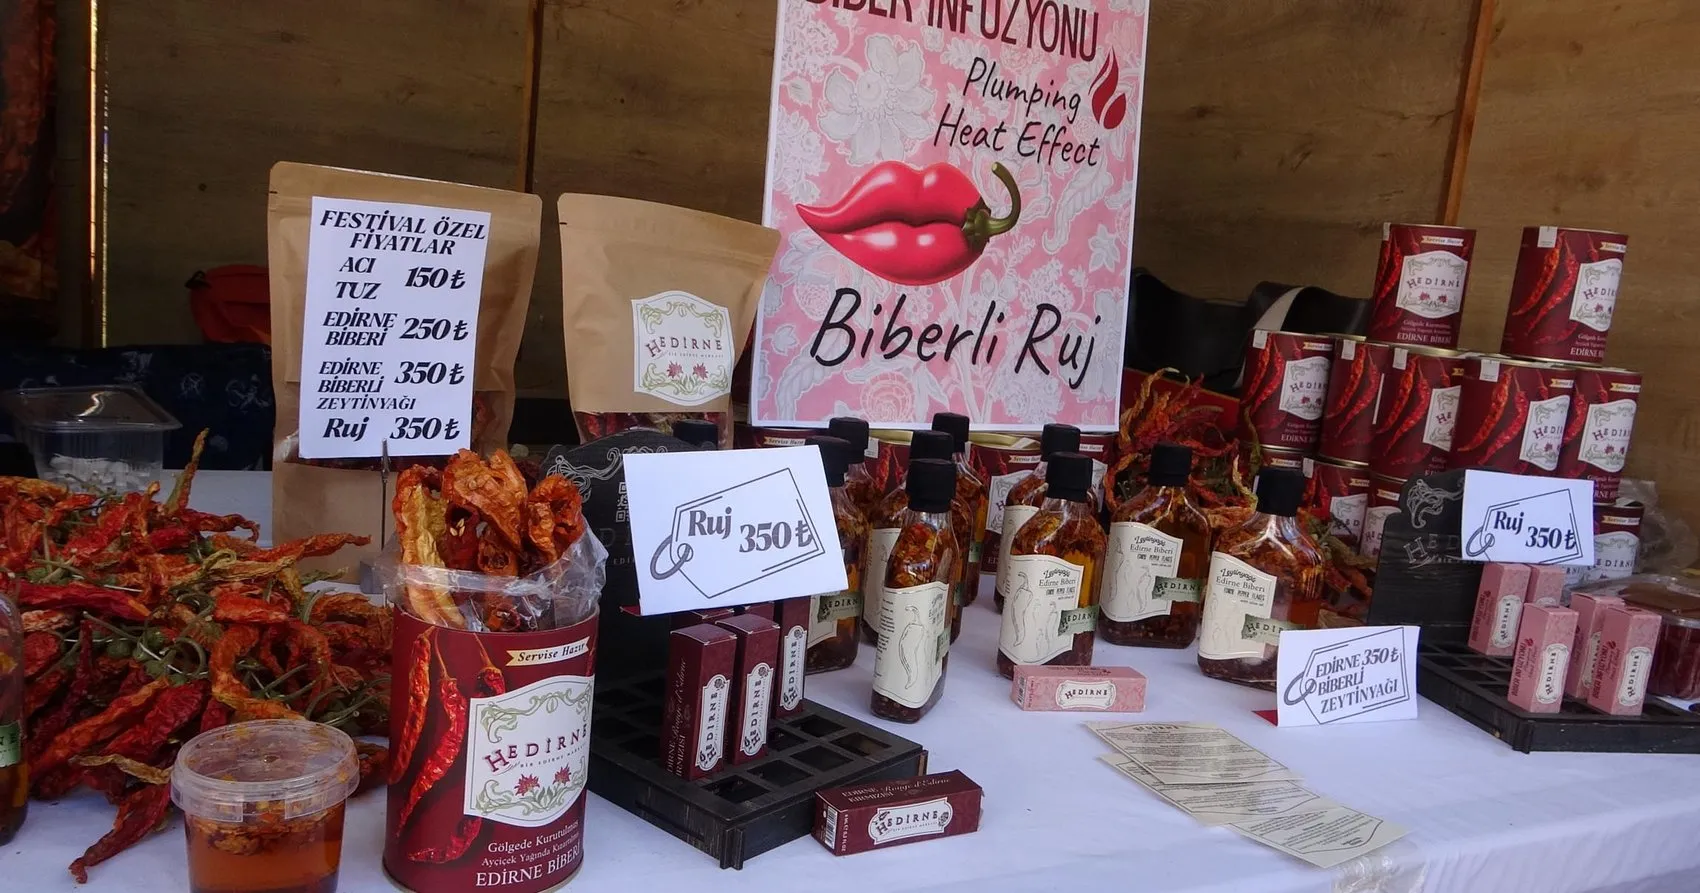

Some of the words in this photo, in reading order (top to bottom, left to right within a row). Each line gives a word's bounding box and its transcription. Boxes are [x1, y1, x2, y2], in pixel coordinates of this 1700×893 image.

[963, 56, 1081, 124] Plumping
[934, 104, 1007, 151] Heat
[1017, 121, 1100, 166] Effect
[320, 210, 427, 234] FESTİVAL
[433, 216, 486, 240] ÖZEL
[349, 229, 456, 255] FİYATLAR
[339, 256, 376, 273] ACI
[336, 281, 381, 300] TUZ
[322, 307, 398, 328] EDİRNE
[325, 327, 388, 346] BİBERİ
[810, 288, 1005, 367] Biberli
[1014, 303, 1102, 389] Ruj
[319, 357, 383, 375] EDİRNE
[317, 376, 385, 393] BİBERLİ
[316, 394, 416, 411] ZEYTİNYAĞI
[323, 416, 370, 442] Ruj
[688, 506, 732, 540] Ruj
[1494, 511, 1524, 535] Ruj
[1216, 576, 1241, 588] Edirne
[1242, 581, 1265, 593] Biberi
[517, 650, 558, 662] Servise
[562, 642, 586, 657] Hazır
[1316, 653, 1361, 679] EDİRNE
[1318, 667, 1365, 697] BİBERLİ
[1320, 678, 1399, 715] ZEYTİNYAĞI
[488, 839, 532, 854] Gölgede
[476, 864, 543, 887] EDİRNE
